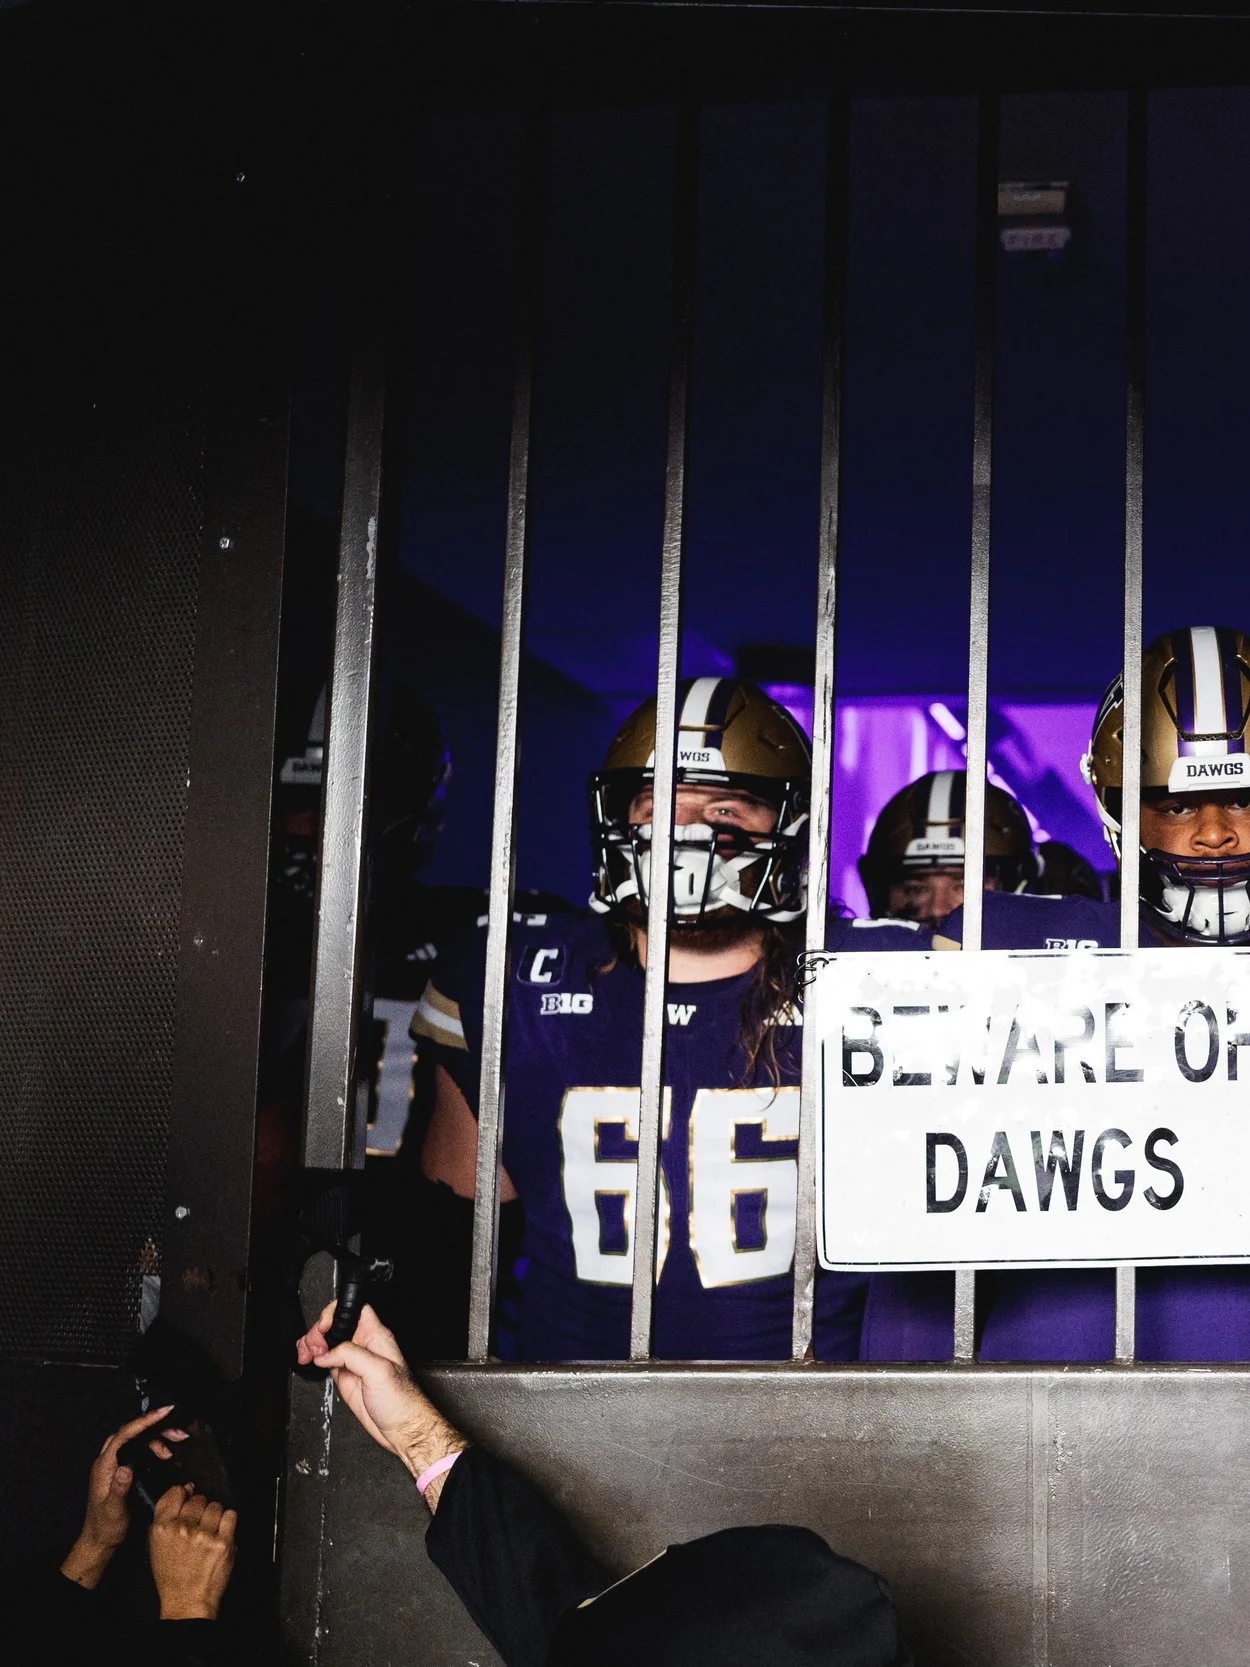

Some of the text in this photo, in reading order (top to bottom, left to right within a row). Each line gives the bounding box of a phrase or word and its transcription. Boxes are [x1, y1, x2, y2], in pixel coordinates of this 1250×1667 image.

[1186, 762, 1244, 777] DAWGS
[530, 948, 559, 983] C
[667, 1003, 697, 1026] W
[557, 1086, 802, 1290] 66
[926, 1127, 1185, 1214] DAWGS
